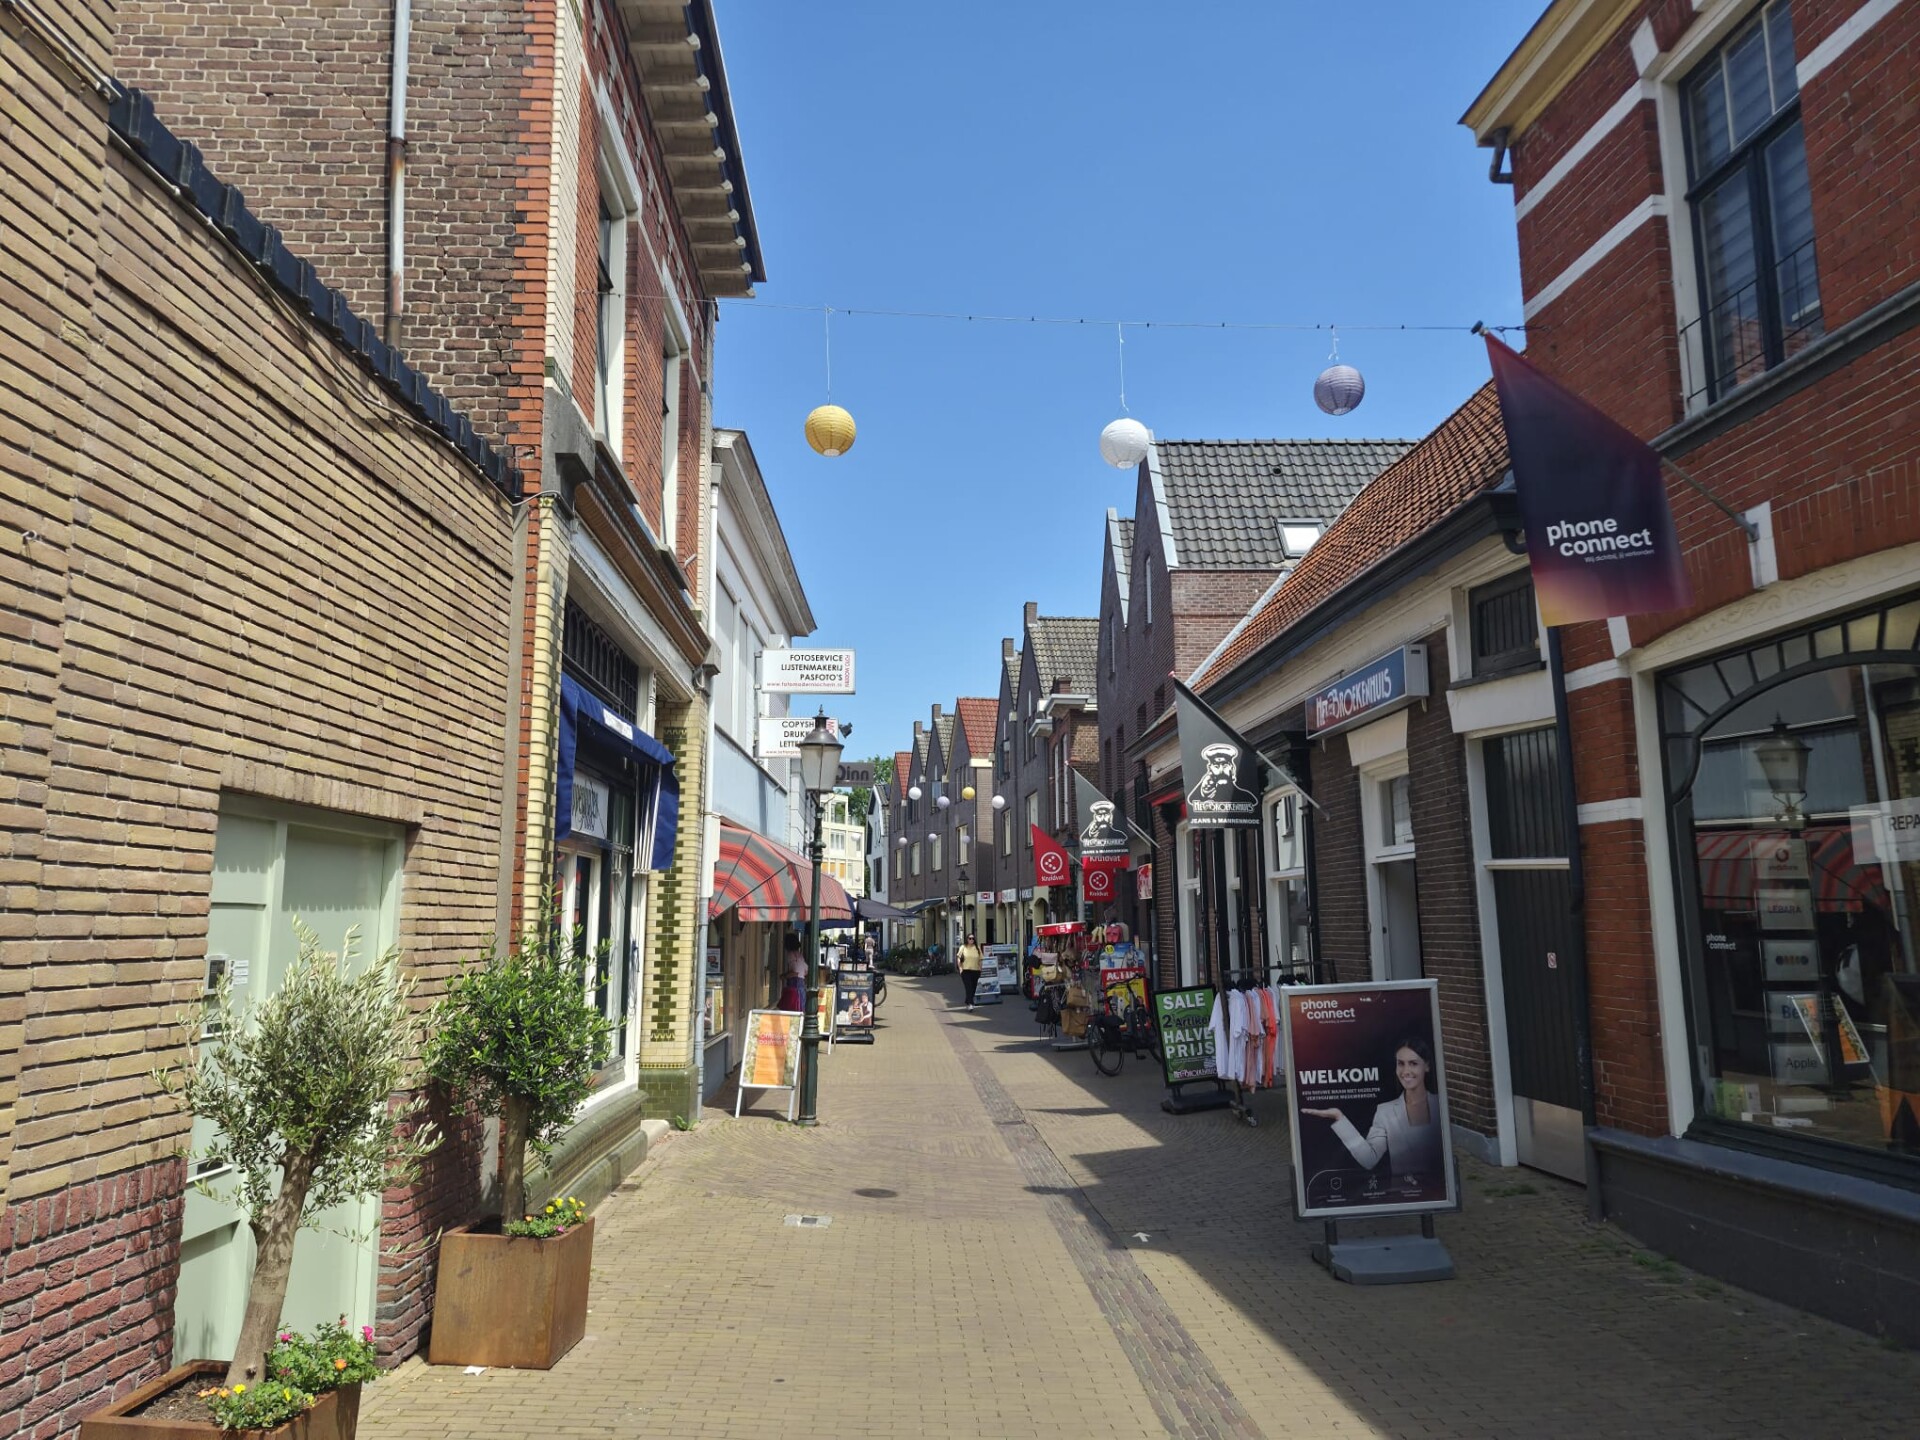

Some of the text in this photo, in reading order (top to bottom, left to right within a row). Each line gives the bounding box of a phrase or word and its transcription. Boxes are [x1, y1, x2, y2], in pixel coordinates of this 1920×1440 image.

[1546, 518, 1618, 547] phone
[1559, 528, 1653, 557] connect
[790, 654, 843, 662] FOTOSERVICE
[781, 664, 843, 672] LIJSTENMAKERIJ
[800, 673, 843, 682] PASFOTO'S
[782, 720, 815, 728] COPYSH
[784, 730, 811, 738] DRUKK
[780, 740, 800, 748] LETTE
[1089, 891, 1109, 899] Kruidvat
[1706, 933, 1727, 944] phone
[1709, 942, 1736, 950] connect
[1163, 992, 1206, 1010] SALE
[1300, 999, 1338, 1013] phone
[1306, 1008, 1356, 1020] connect
[1163, 1027, 1214, 1044] HALVE
[1166, 1042, 1215, 1059] PRIJS
[1785, 1057, 1818, 1074] Apple
[1299, 1067, 1379, 1085] WELKOM
